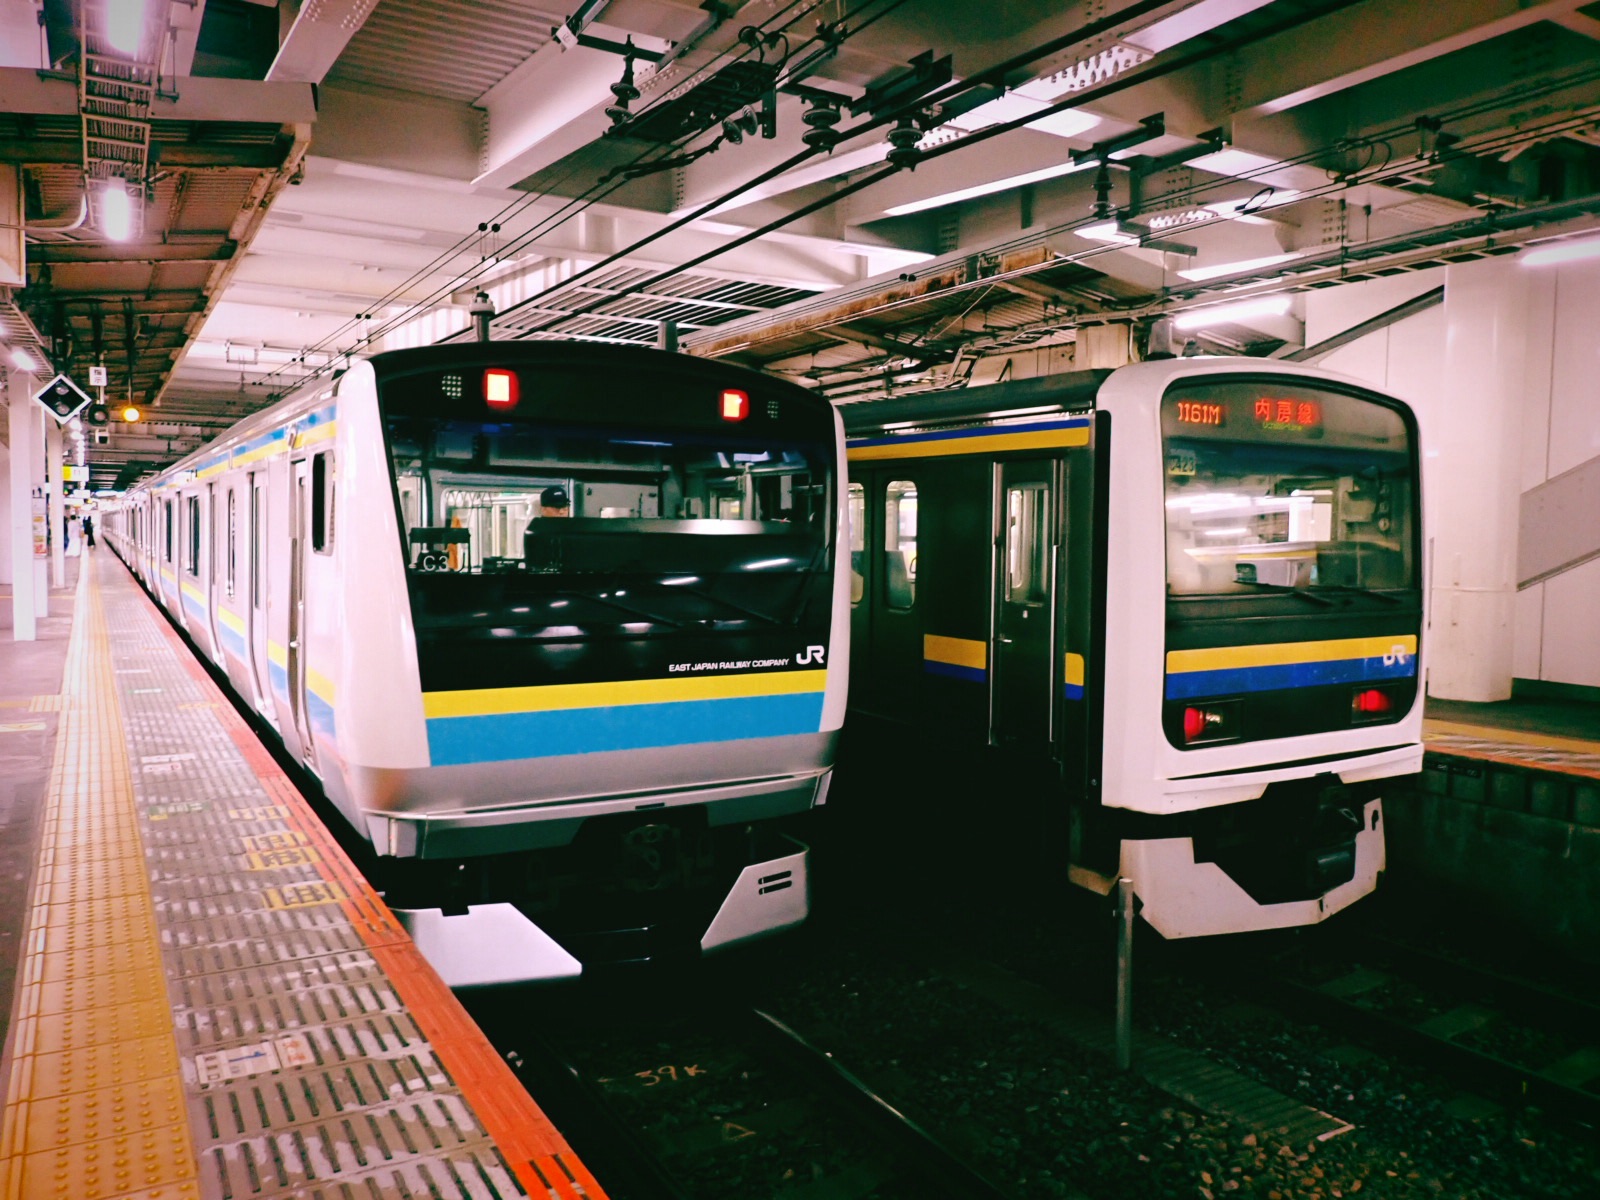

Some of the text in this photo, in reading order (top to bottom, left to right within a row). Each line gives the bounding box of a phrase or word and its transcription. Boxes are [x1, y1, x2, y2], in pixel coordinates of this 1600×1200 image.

[1177, 402, 1220, 425] 1161M
[1255, 398, 1313, 425] 内房線
[668, 658, 789, 672] EAST JAPAN RAILWAY COMPANY
[796, 645, 825, 665] JR
[1382, 644, 1406, 667] JR
